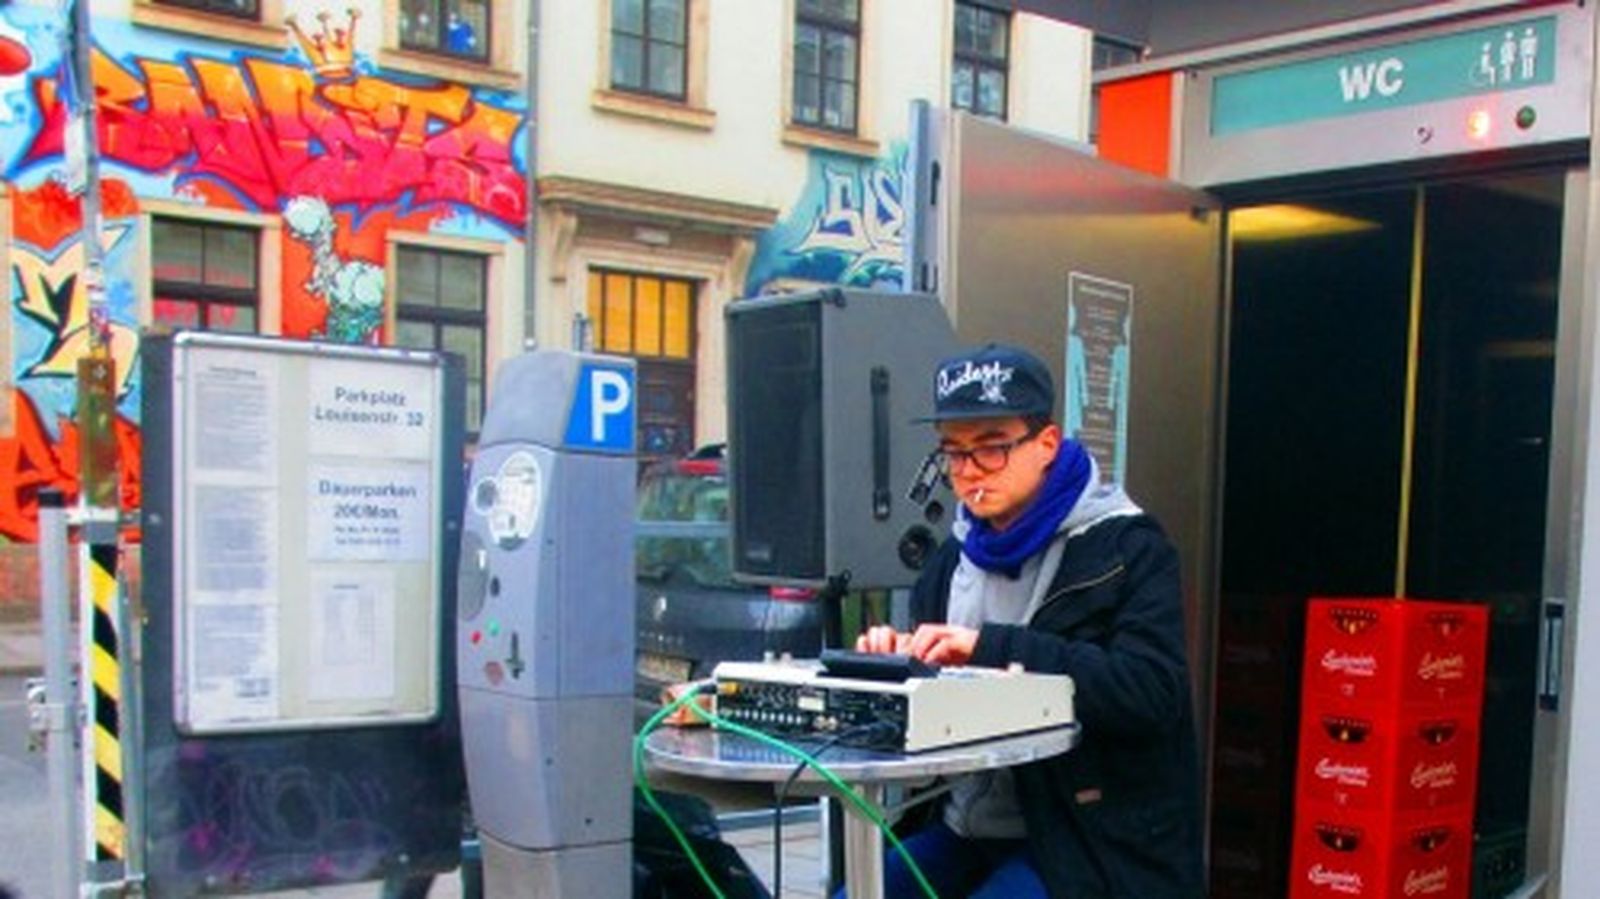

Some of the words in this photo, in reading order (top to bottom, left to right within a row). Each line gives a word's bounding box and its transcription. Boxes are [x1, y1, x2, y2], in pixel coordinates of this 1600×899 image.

[1339, 58, 1403, 102] WC
[334, 386, 407, 406] Parkplatz
[591, 370, 630, 441] P
[318, 480, 417, 497] Dauerparken
